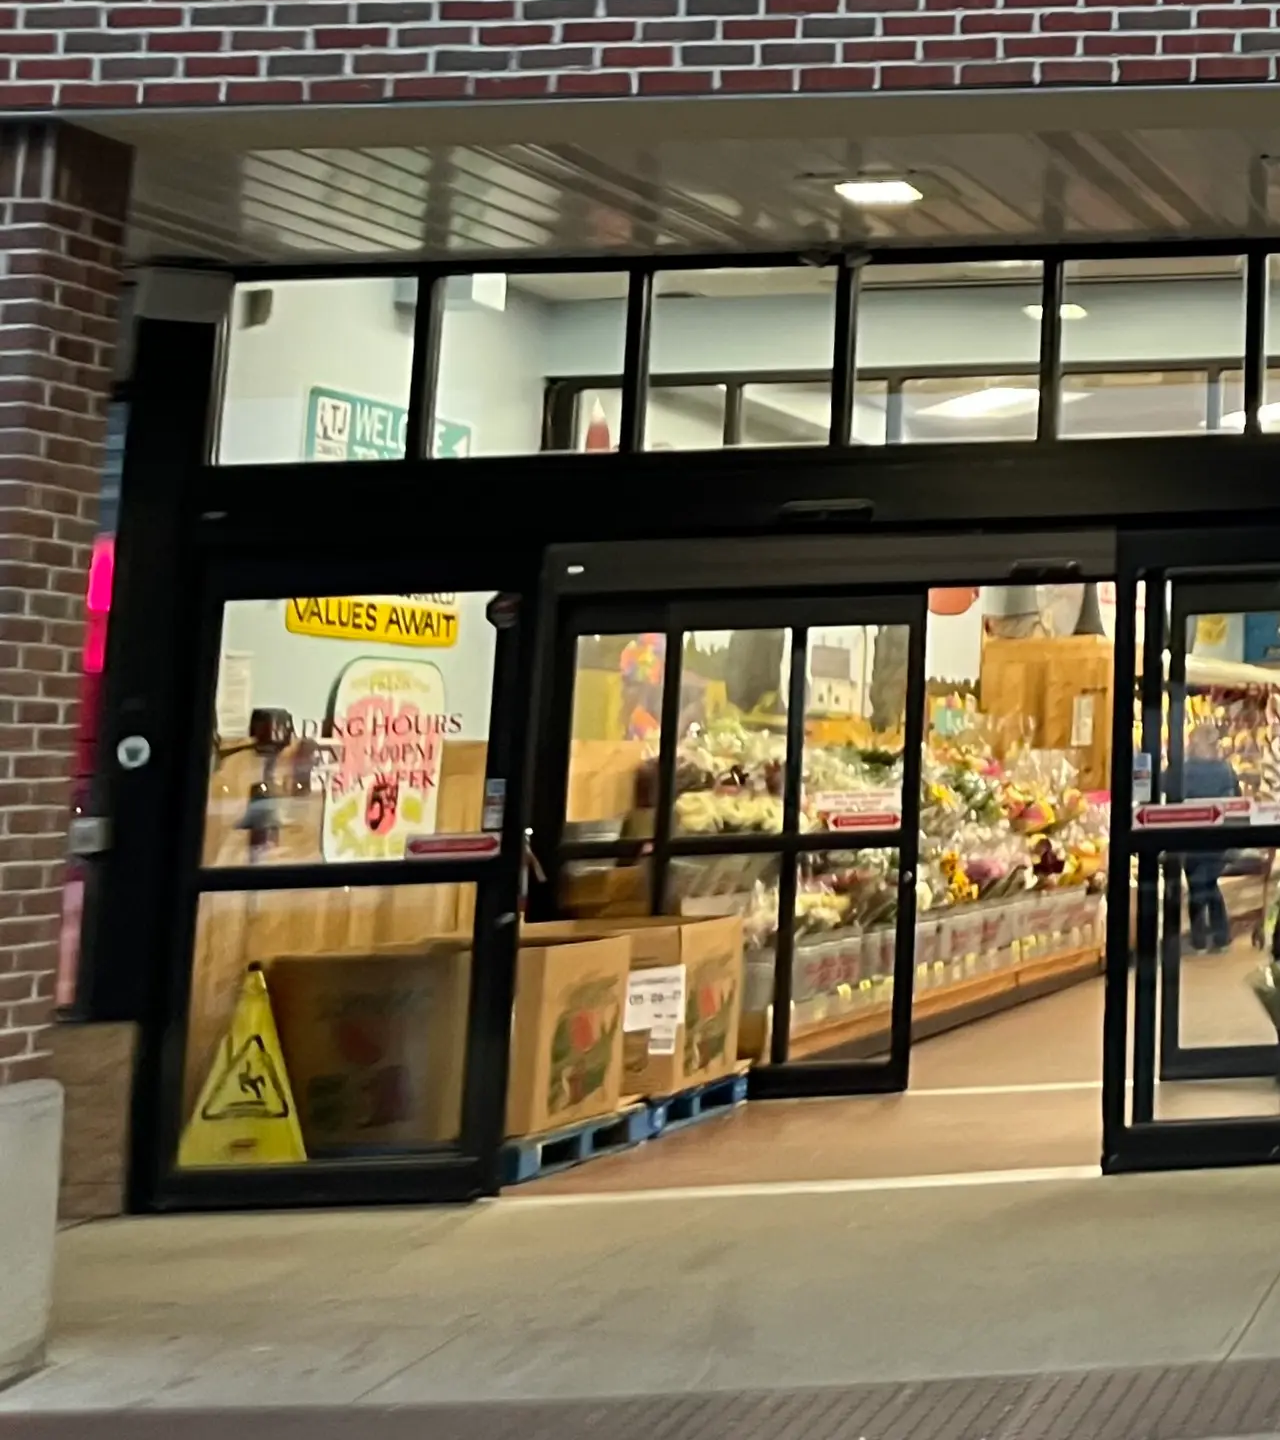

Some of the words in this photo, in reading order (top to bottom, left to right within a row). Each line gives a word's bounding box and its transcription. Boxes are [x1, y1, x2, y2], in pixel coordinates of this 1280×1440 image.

[356, 402, 446, 453] WELE
[293, 596, 378, 631] VALUES
[385, 607, 456, 638] AWAIT
[372, 713, 463, 736] HOURS
